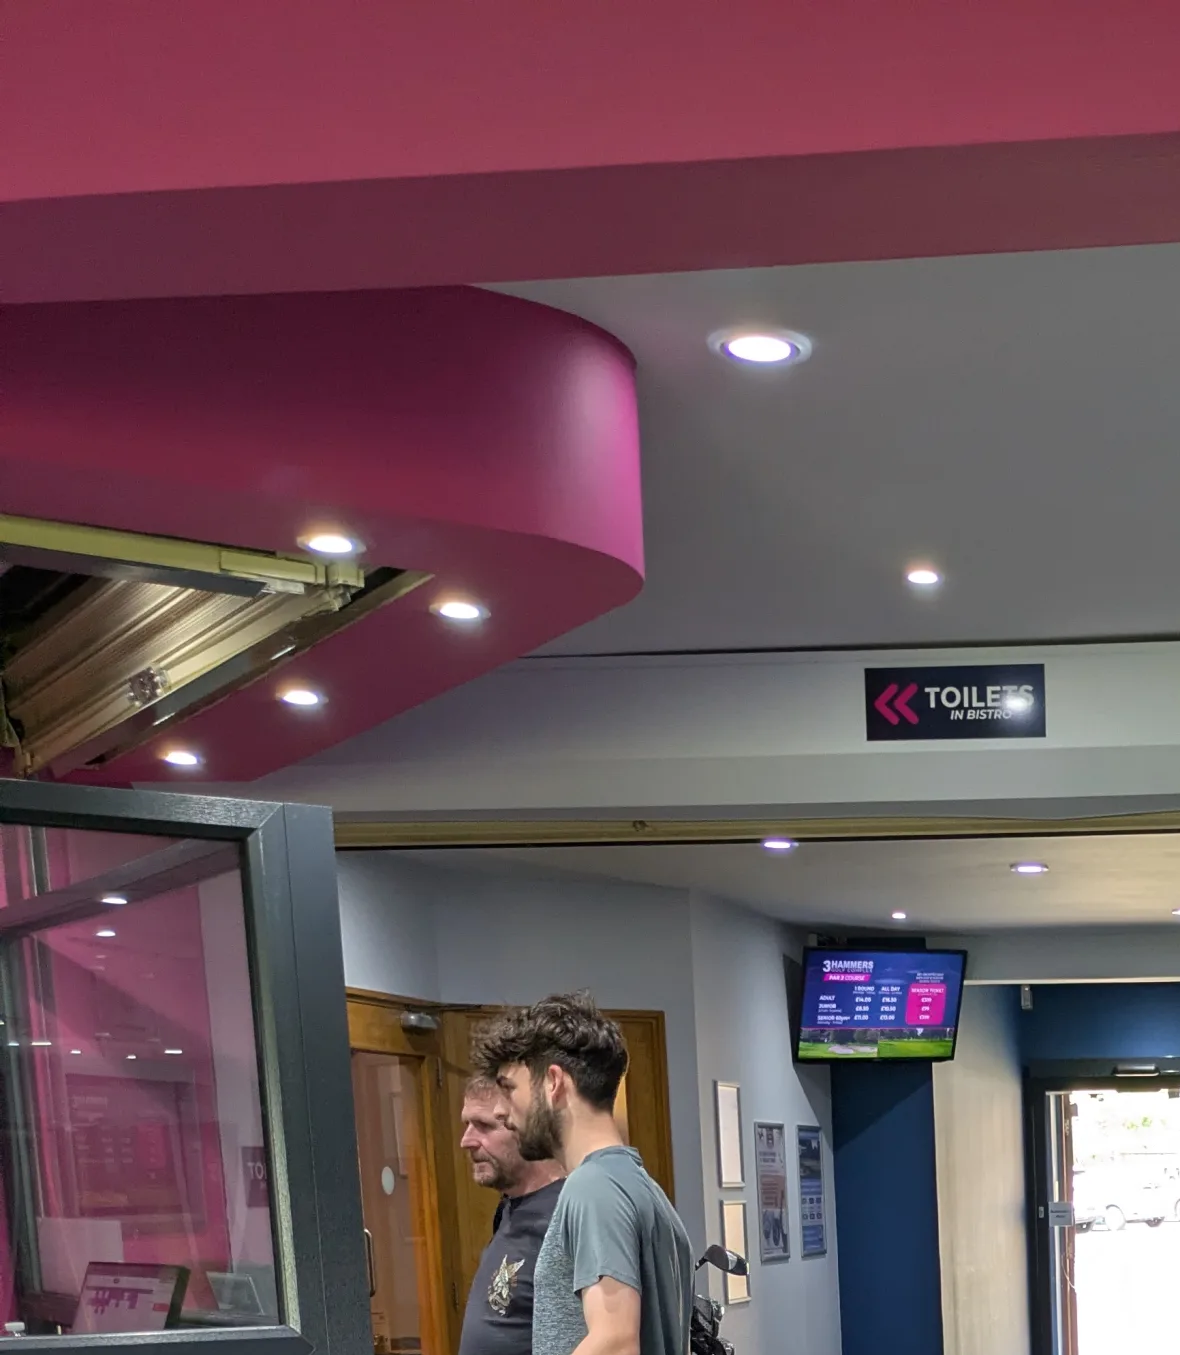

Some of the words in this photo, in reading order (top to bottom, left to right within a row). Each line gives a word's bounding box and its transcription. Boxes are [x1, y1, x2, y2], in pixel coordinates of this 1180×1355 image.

[950, 710, 964, 720] IN
[967, 709, 1012, 720] BISTRO
[822, 960, 831, 972] 3
[831, 960, 874, 969] HAMMERS
